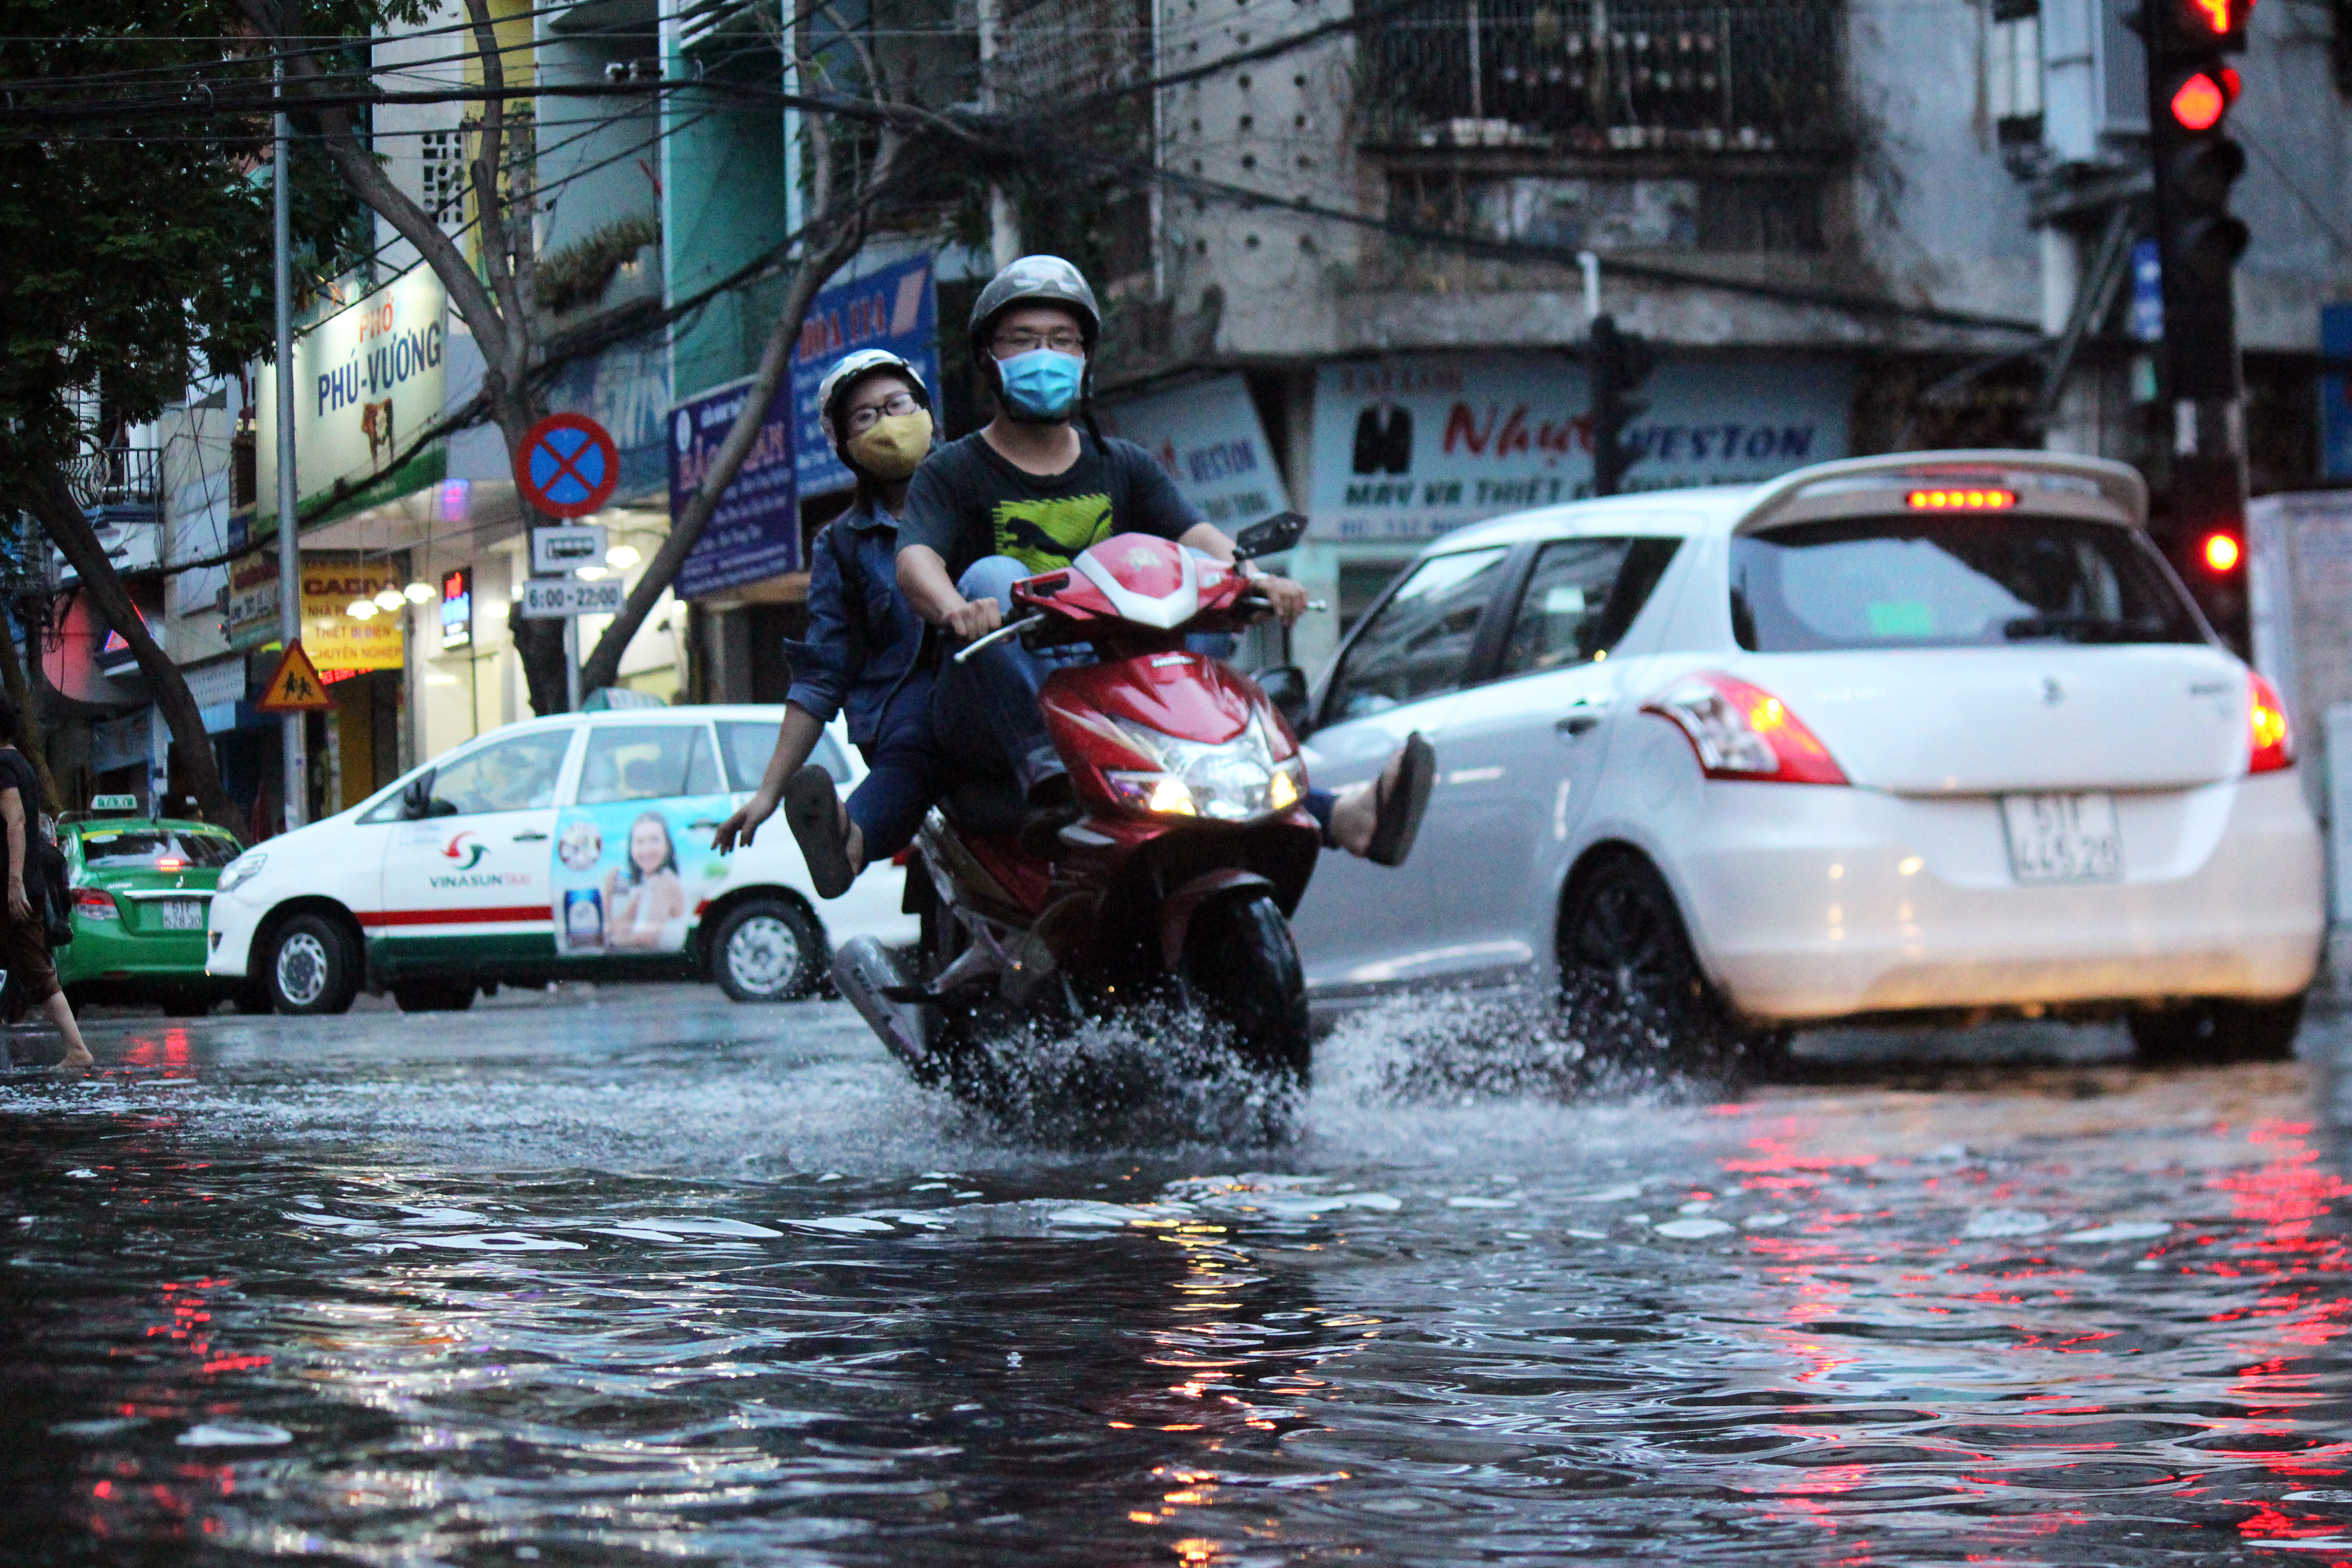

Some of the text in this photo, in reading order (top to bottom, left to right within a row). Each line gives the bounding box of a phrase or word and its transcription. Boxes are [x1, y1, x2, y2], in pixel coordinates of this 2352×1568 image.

[360, 291, 394, 343] PHỞ
[318, 320, 441, 416] PHÚ-VƯƠNG
[529, 588, 564, 608] 6:00
[103, 797, 129, 807] TAXI
[430, 874, 503, 887] VINASUN
